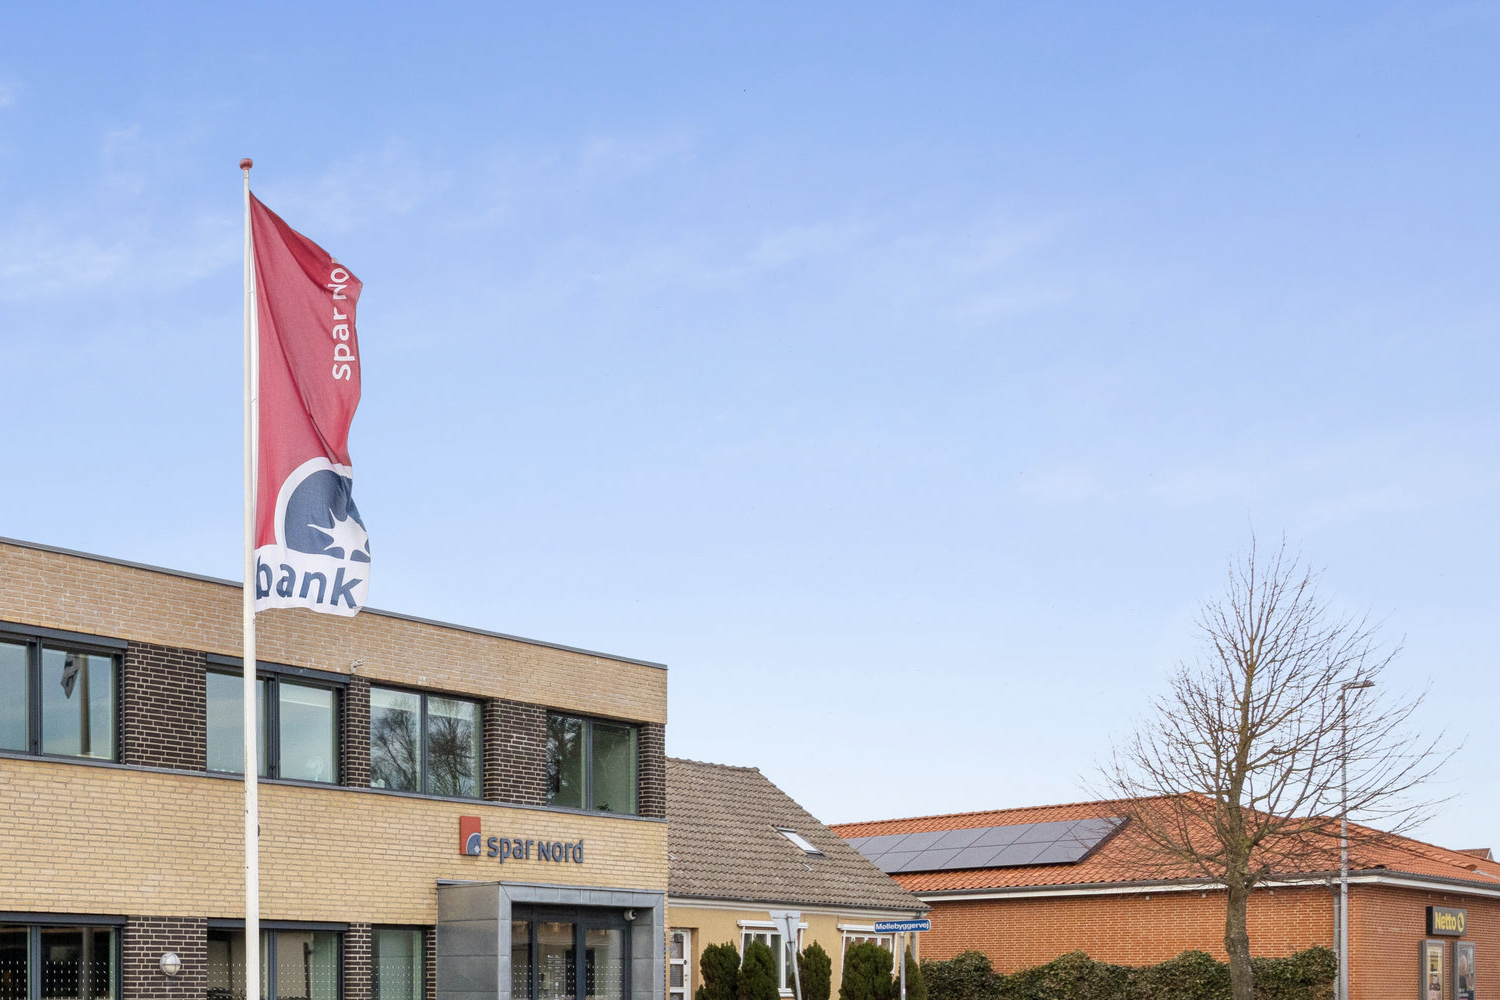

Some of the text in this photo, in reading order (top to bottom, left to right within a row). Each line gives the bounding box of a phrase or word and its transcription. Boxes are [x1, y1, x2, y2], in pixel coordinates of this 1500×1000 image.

[328, 257, 356, 381] spar No
[256, 554, 363, 609] bank
[487, 836, 584, 864] spar Nord
[875, 921, 929, 930] Møllebyggervej
[1434, 911, 1457, 931] Netto
